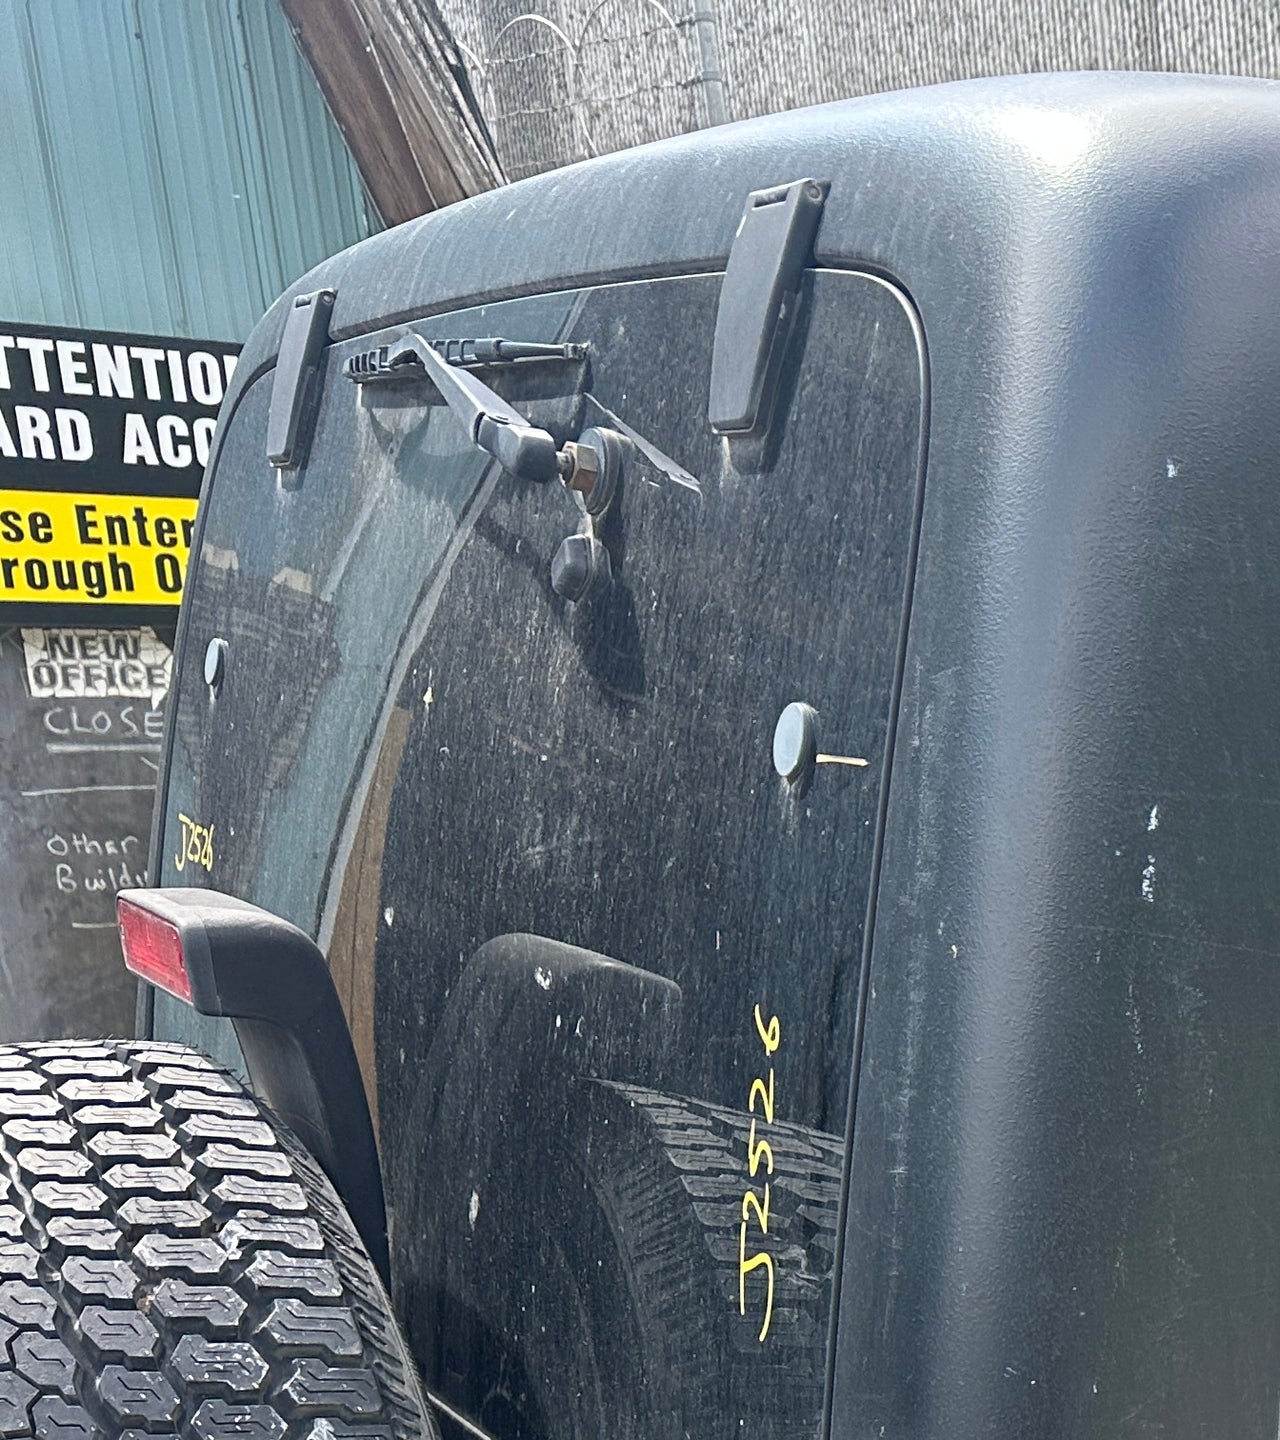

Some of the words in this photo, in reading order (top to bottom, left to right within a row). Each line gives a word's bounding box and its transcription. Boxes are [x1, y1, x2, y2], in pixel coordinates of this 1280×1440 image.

[1, 510, 52, 543] se
[48, 634, 140, 659] NEW
[32, 660, 167, 689] OFFICE
[47, 833, 139, 856] Other
[175, 812, 214, 871] J2526
[740, 1003, 780, 1342] J2526
